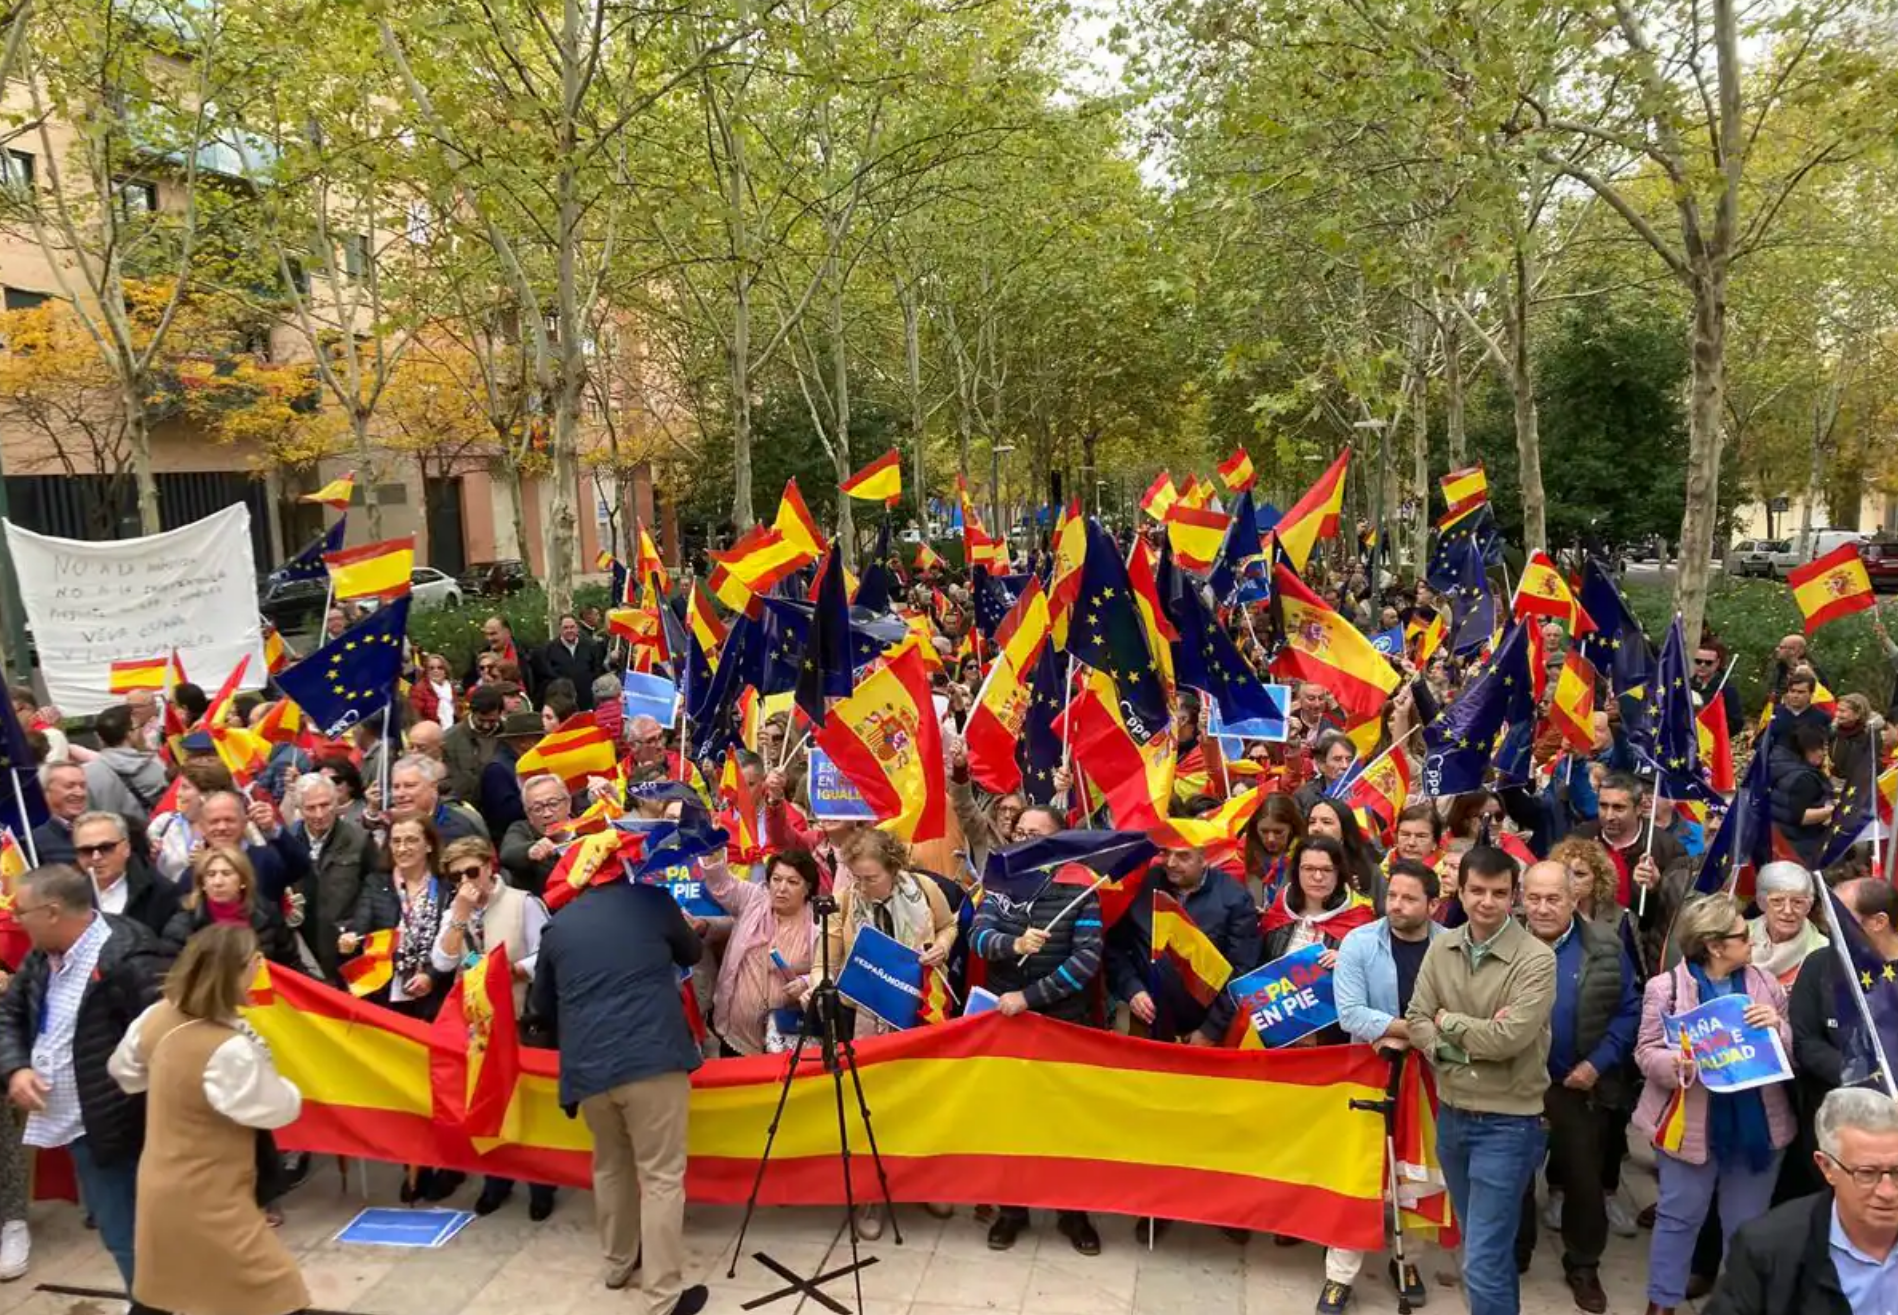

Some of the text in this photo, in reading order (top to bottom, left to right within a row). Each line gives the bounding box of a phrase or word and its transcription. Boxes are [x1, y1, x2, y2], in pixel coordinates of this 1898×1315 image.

[1126, 716, 1151, 740] ppe
[1427, 770, 1440, 795] ppe
[673, 882, 701, 900] PIE
[1250, 987, 1320, 1032] EN PIE
